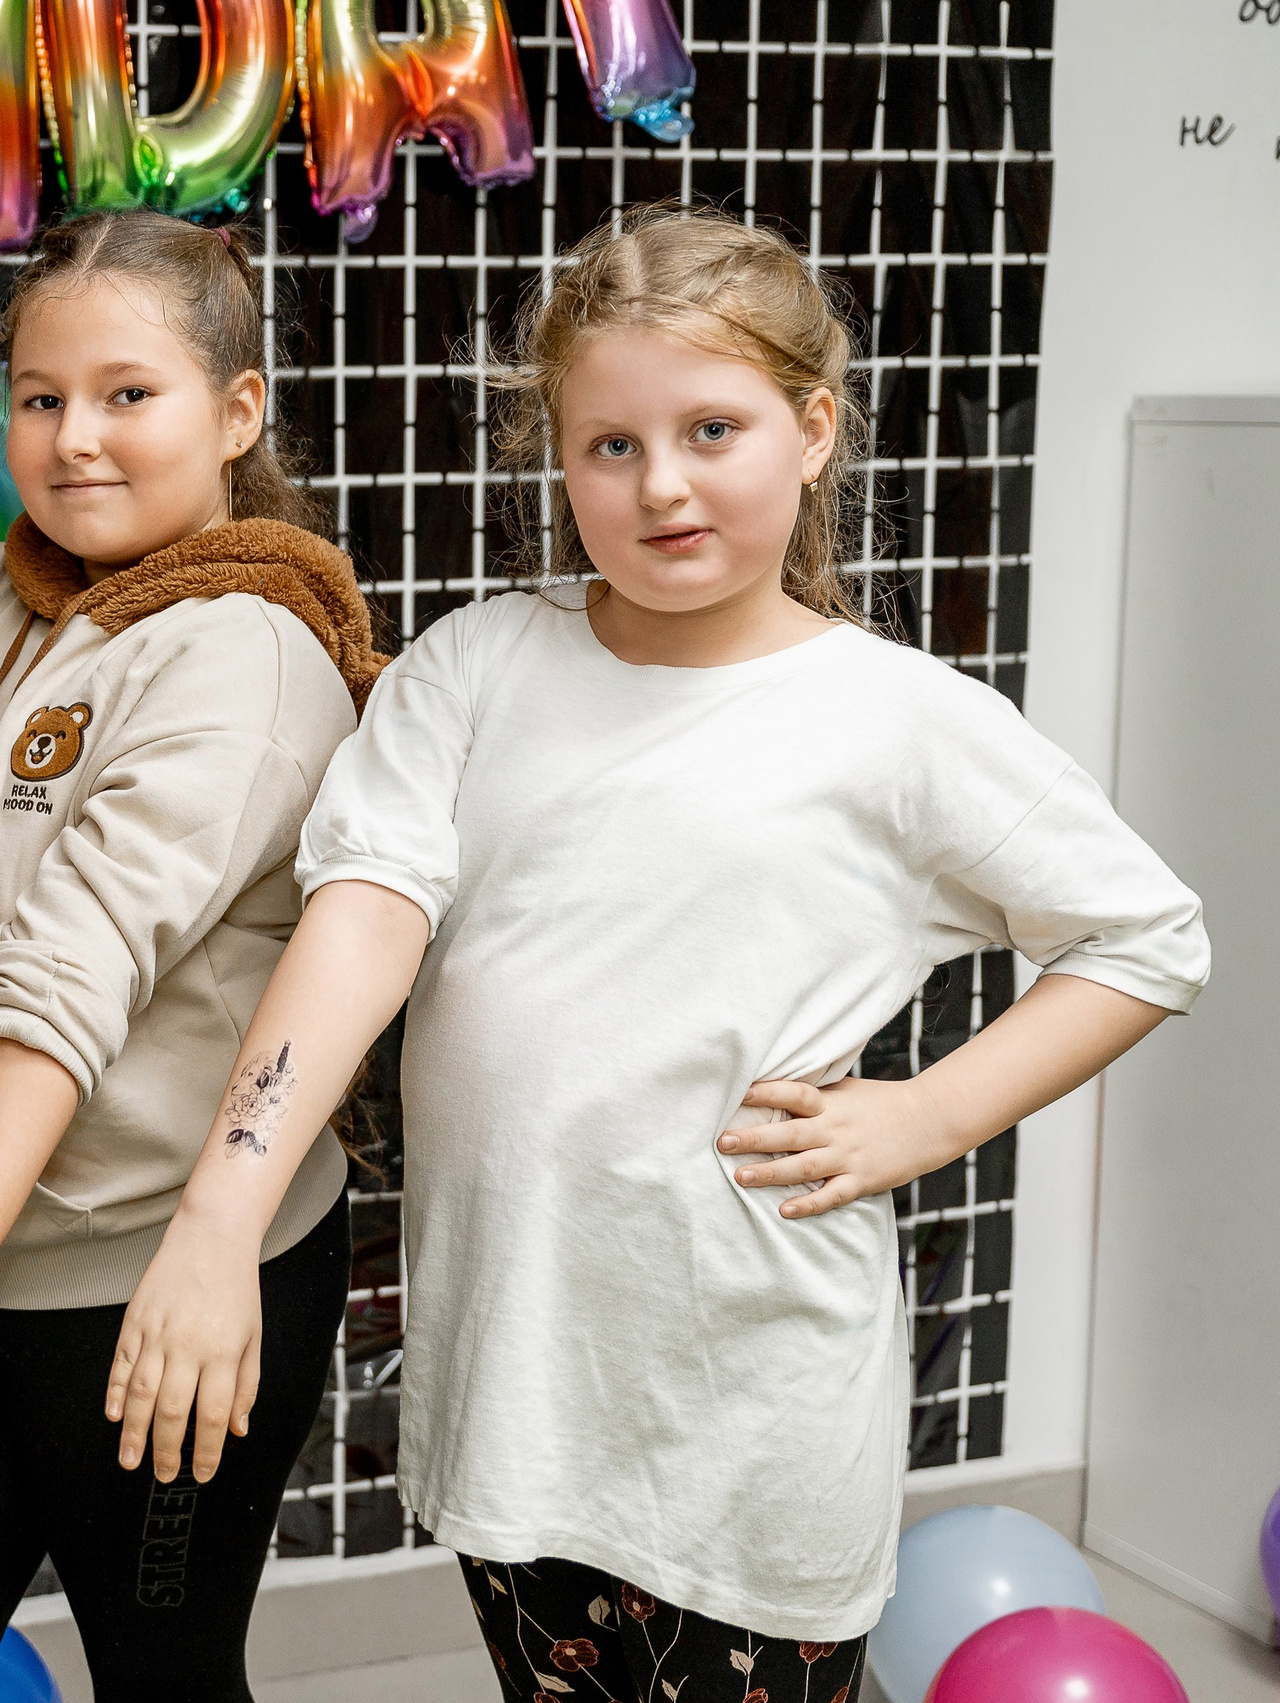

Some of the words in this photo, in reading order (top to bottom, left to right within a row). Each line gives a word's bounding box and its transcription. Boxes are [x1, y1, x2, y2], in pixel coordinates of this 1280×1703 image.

[10, 784, 47, 800] RELAX
[2, 799, 34, 813] MOOD
[36, 802, 53, 815] ON
